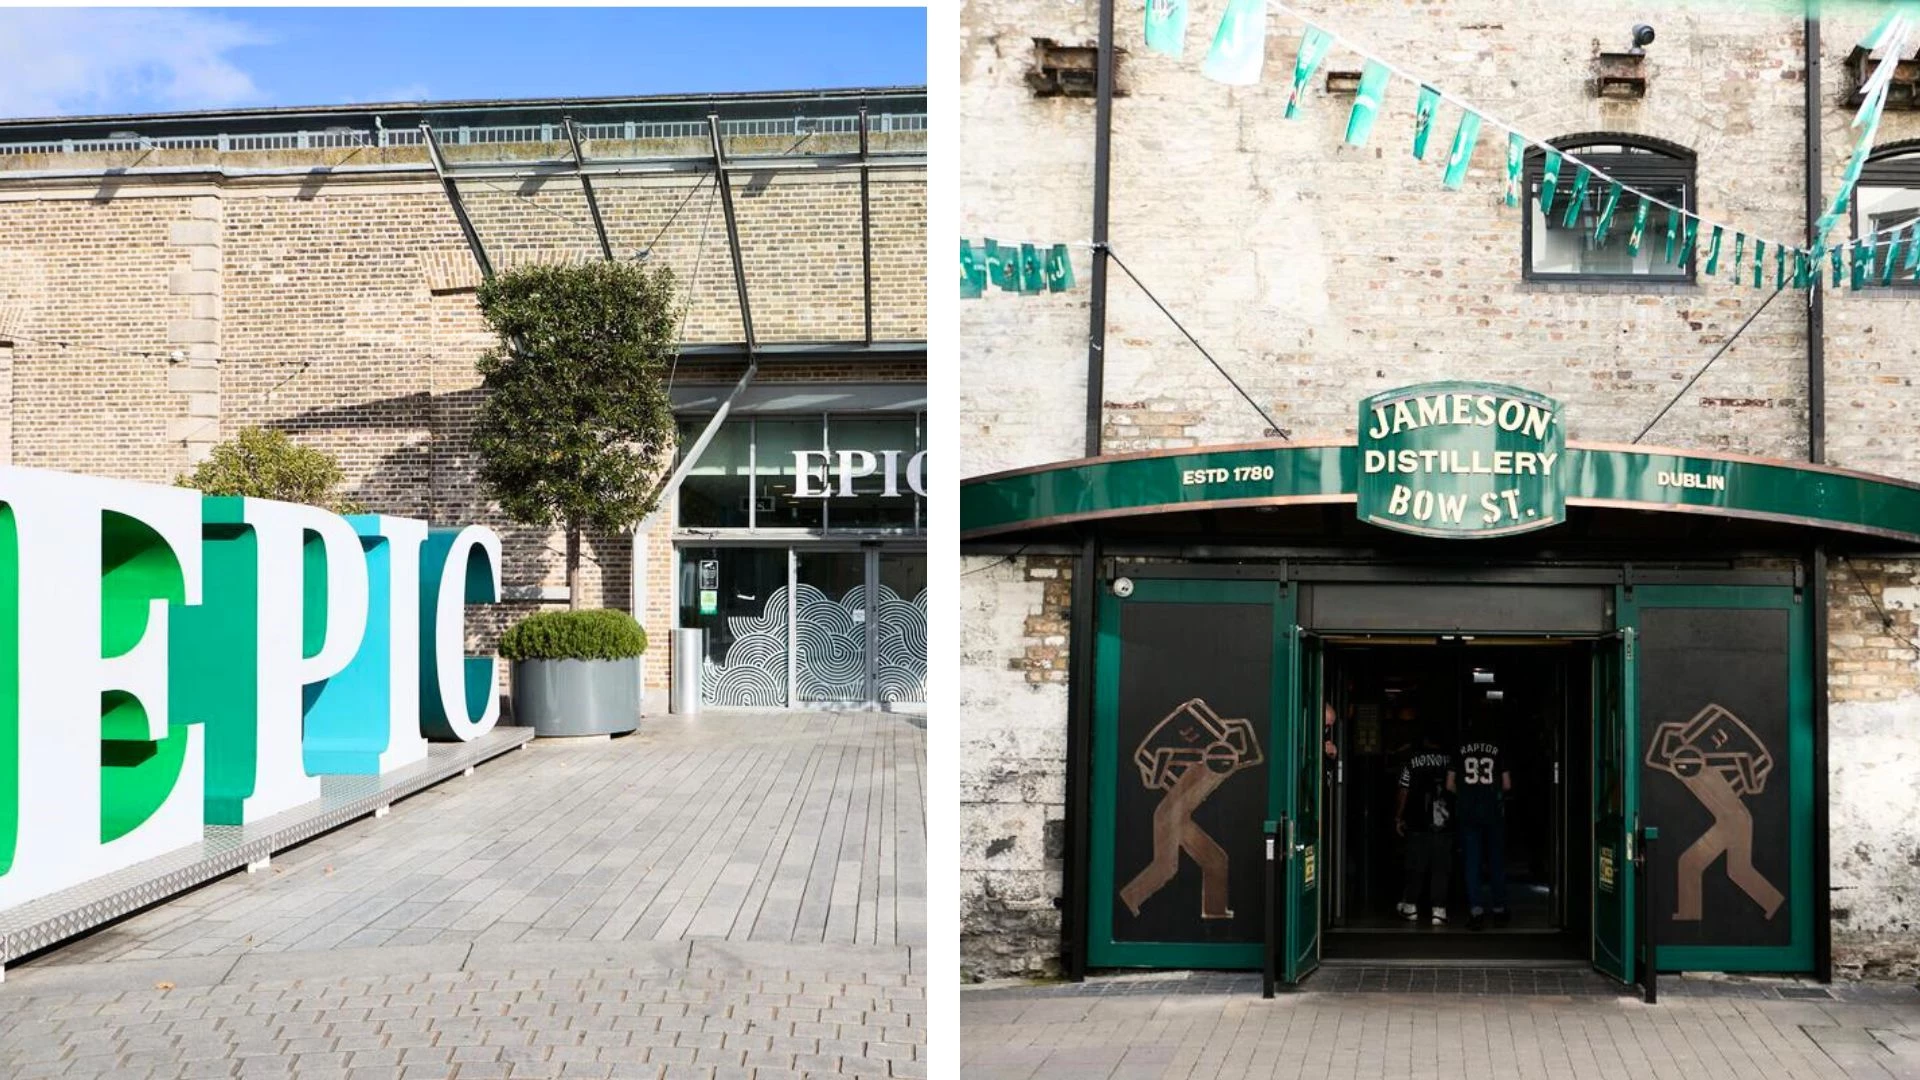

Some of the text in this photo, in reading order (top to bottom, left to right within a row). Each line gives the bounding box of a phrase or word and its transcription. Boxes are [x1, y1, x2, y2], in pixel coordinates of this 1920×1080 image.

[1369, 393, 1552, 441] JAMESON
[1182, 464, 1275, 485] ESTD 1780
[1365, 449, 1558, 476] DISTILLERY
[1657, 470, 1725, 491] DUBLIN
[1387, 483, 1535, 524] BOW ST.
[0, 466, 502, 910] EPIC
[1460, 742, 1499, 756] RAPTOR
[1463, 756, 1495, 785] 93
